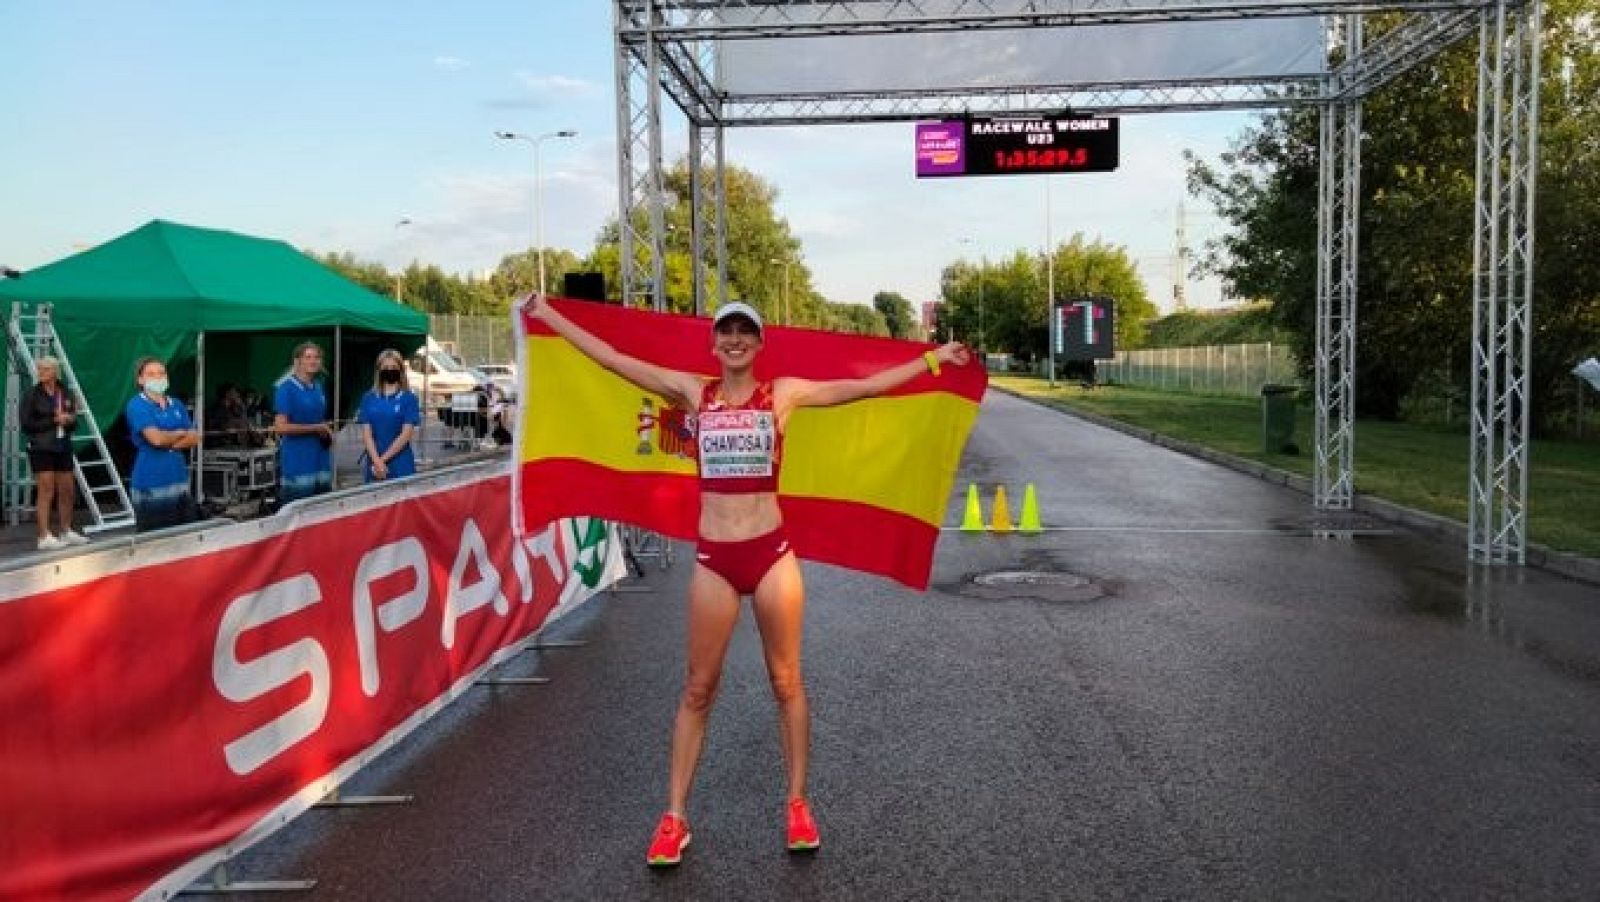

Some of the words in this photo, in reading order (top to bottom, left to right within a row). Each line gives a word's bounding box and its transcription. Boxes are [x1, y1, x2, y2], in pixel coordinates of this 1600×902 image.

[972, 121, 1052, 134] RACEWALK
[1056, 119, 1109, 131] WOMEN
[1027, 133, 1054, 145] U23
[703, 434, 763, 453] CHAMOSA
